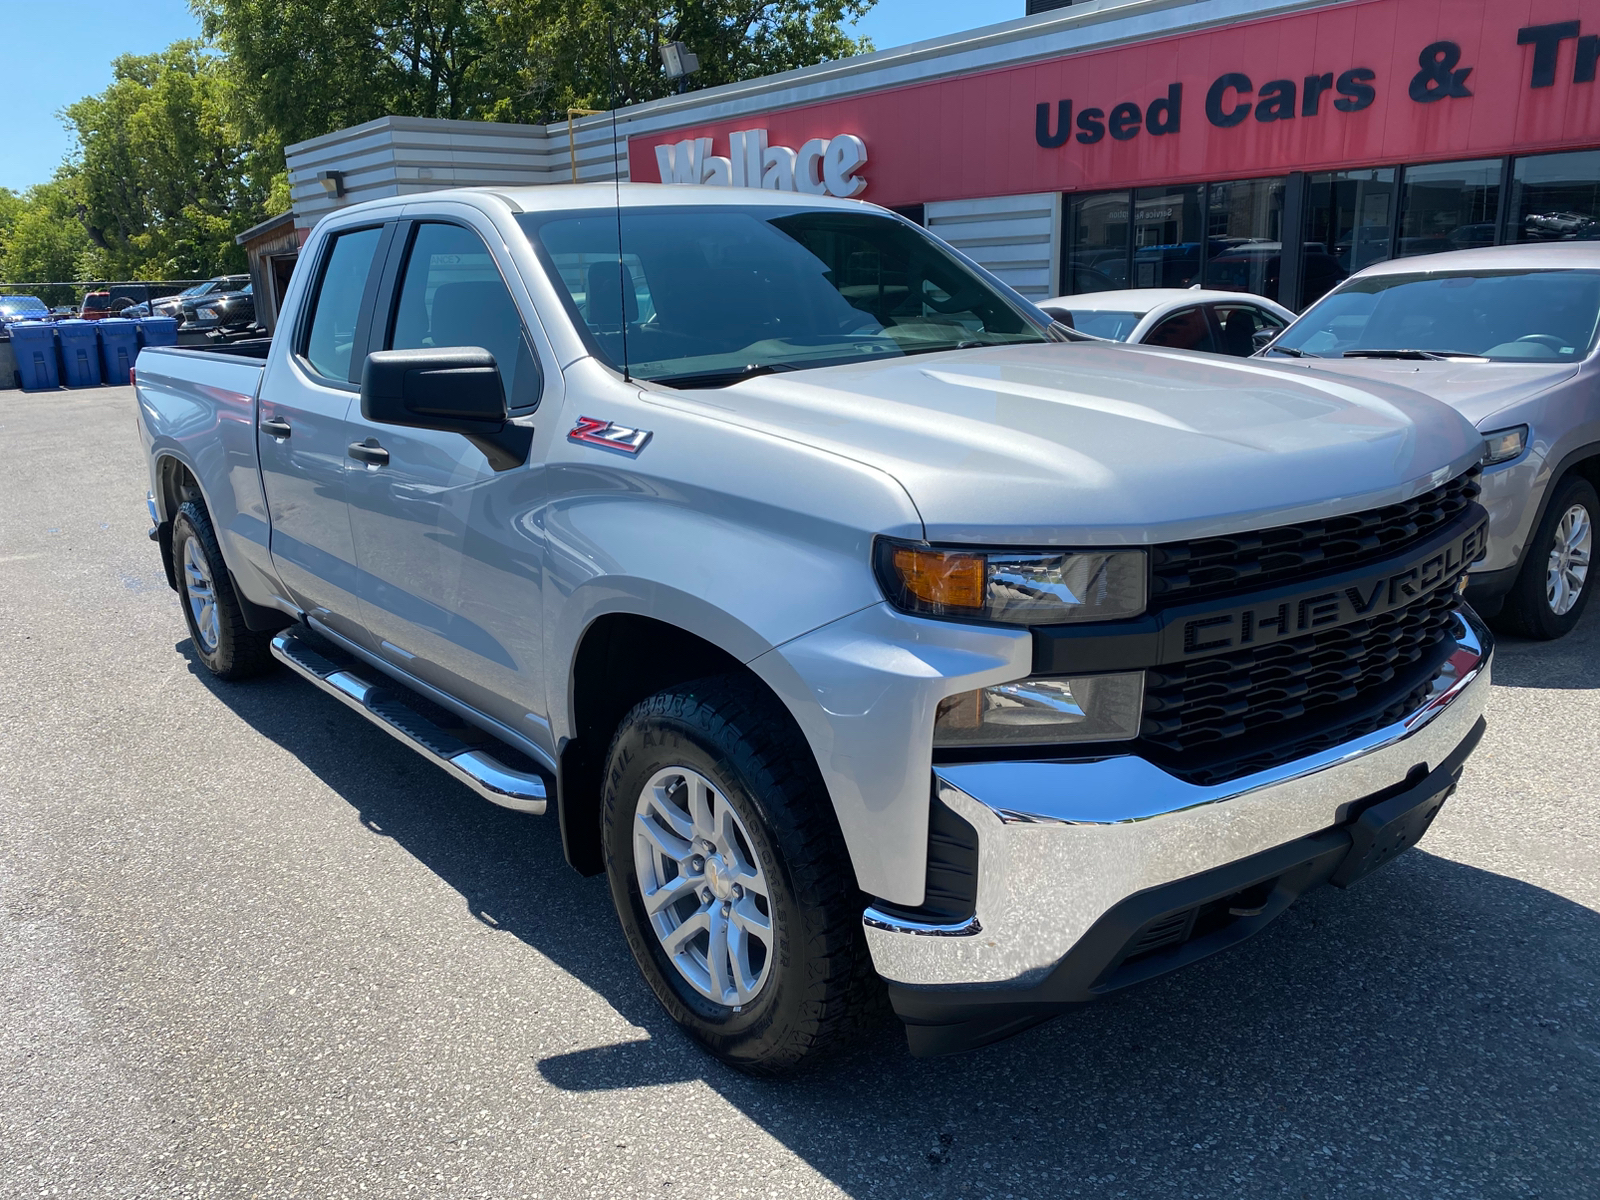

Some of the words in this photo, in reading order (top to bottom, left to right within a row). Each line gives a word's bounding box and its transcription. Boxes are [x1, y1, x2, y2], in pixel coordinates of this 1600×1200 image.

[1035, 82, 1183, 149] Used
[1205, 68, 1376, 128] Cars
[1408, 40, 1473, 103] &
[654, 128, 868, 197] Wallace
[566, 414, 655, 457] Z71
[1183, 518, 1488, 654] CHEVROLET
[738, 797, 790, 969] MOTOMASTER
